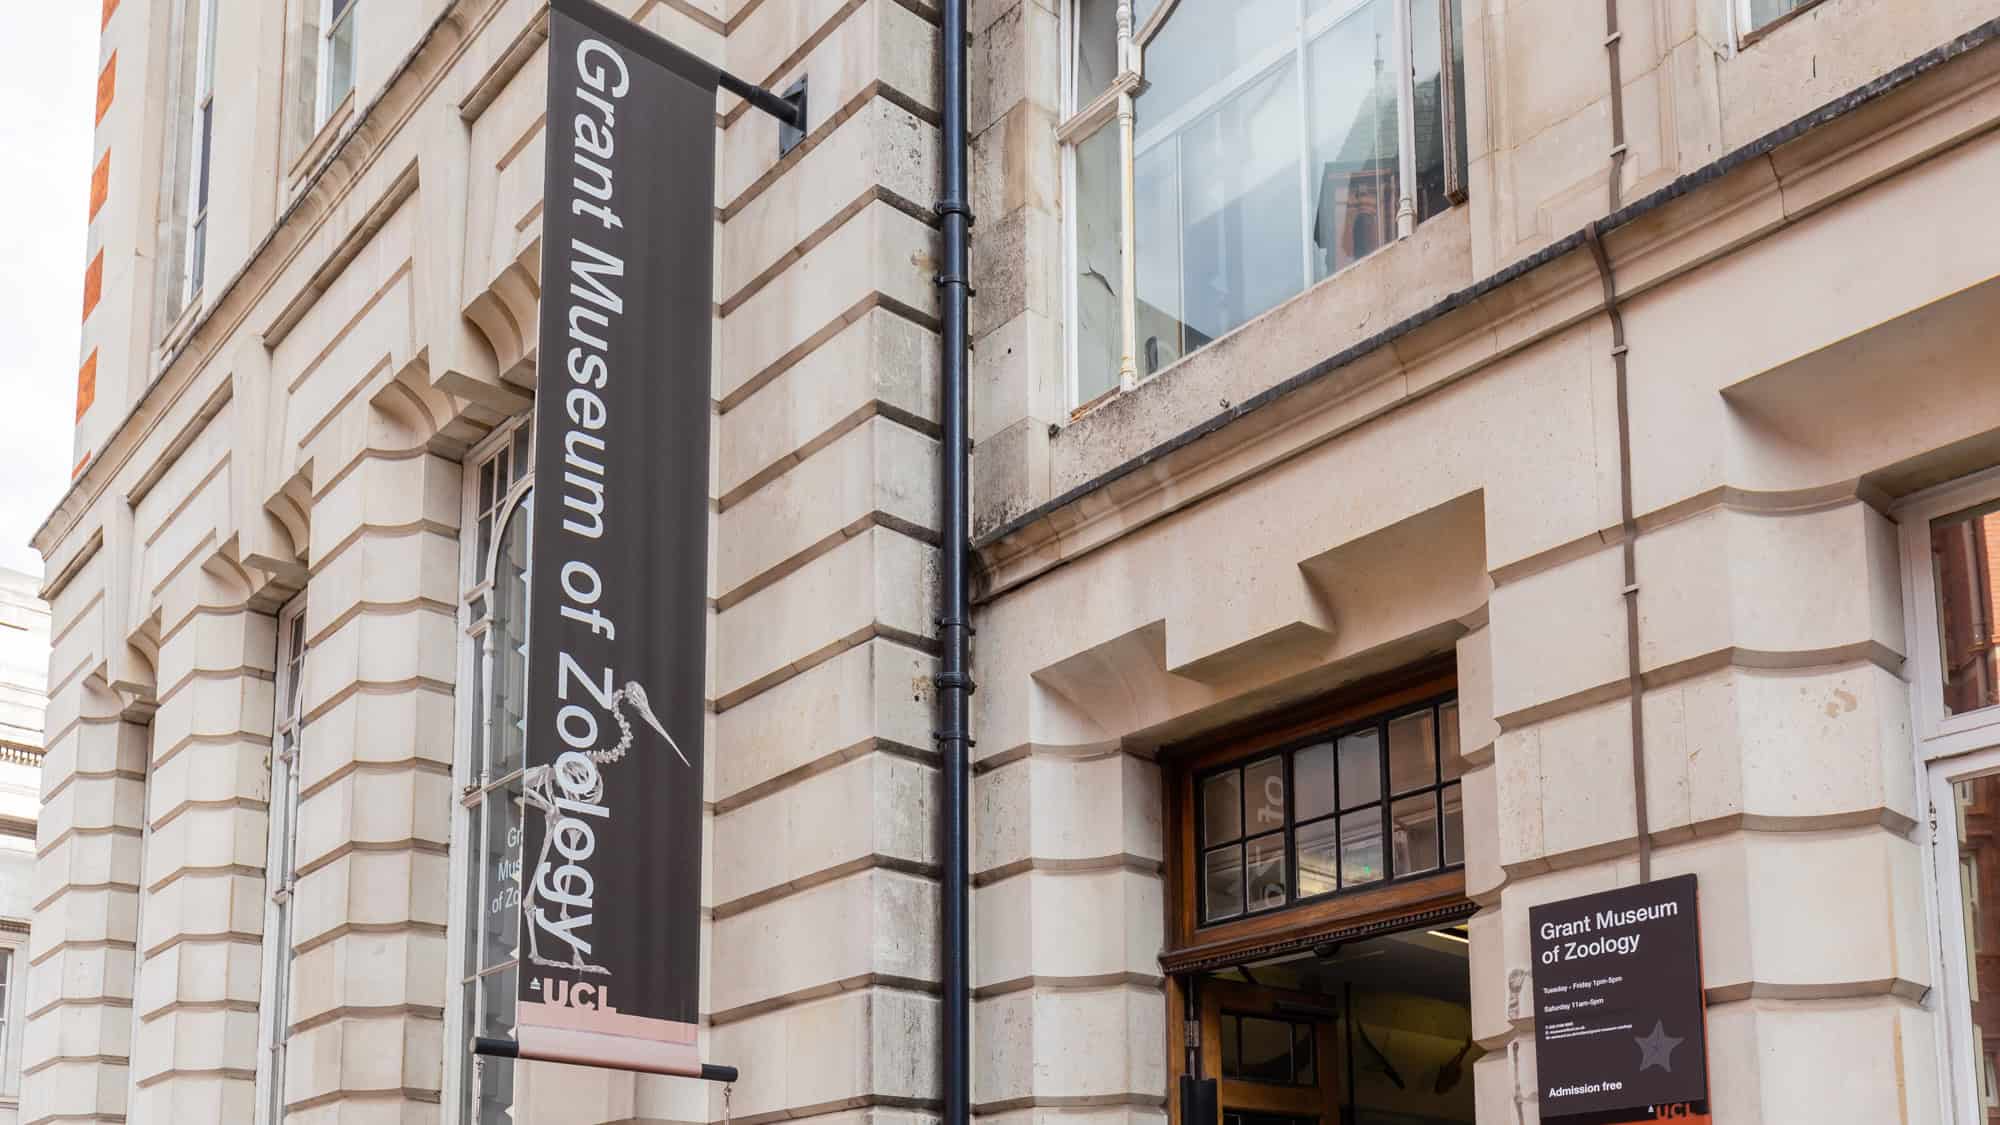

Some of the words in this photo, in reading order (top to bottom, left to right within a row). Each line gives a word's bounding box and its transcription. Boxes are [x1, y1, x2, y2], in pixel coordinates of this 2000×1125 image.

[573, 39, 630, 229] Grant
[564, 238, 624, 539] Museum
[560, 560, 615, 641] of
[535, 651, 613, 955] Zoology
[492, 890, 503, 912] of
[1540, 915, 1592, 940] Grant
[1596, 901, 1678, 930] Museum
[1541, 944, 1560, 965] of
[1564, 933, 1641, 961] Zoology
[543, 977, 617, 1013] UCL
[1548, 1083, 1601, 1098] Admission
[1602, 1081, 1623, 1092] free
